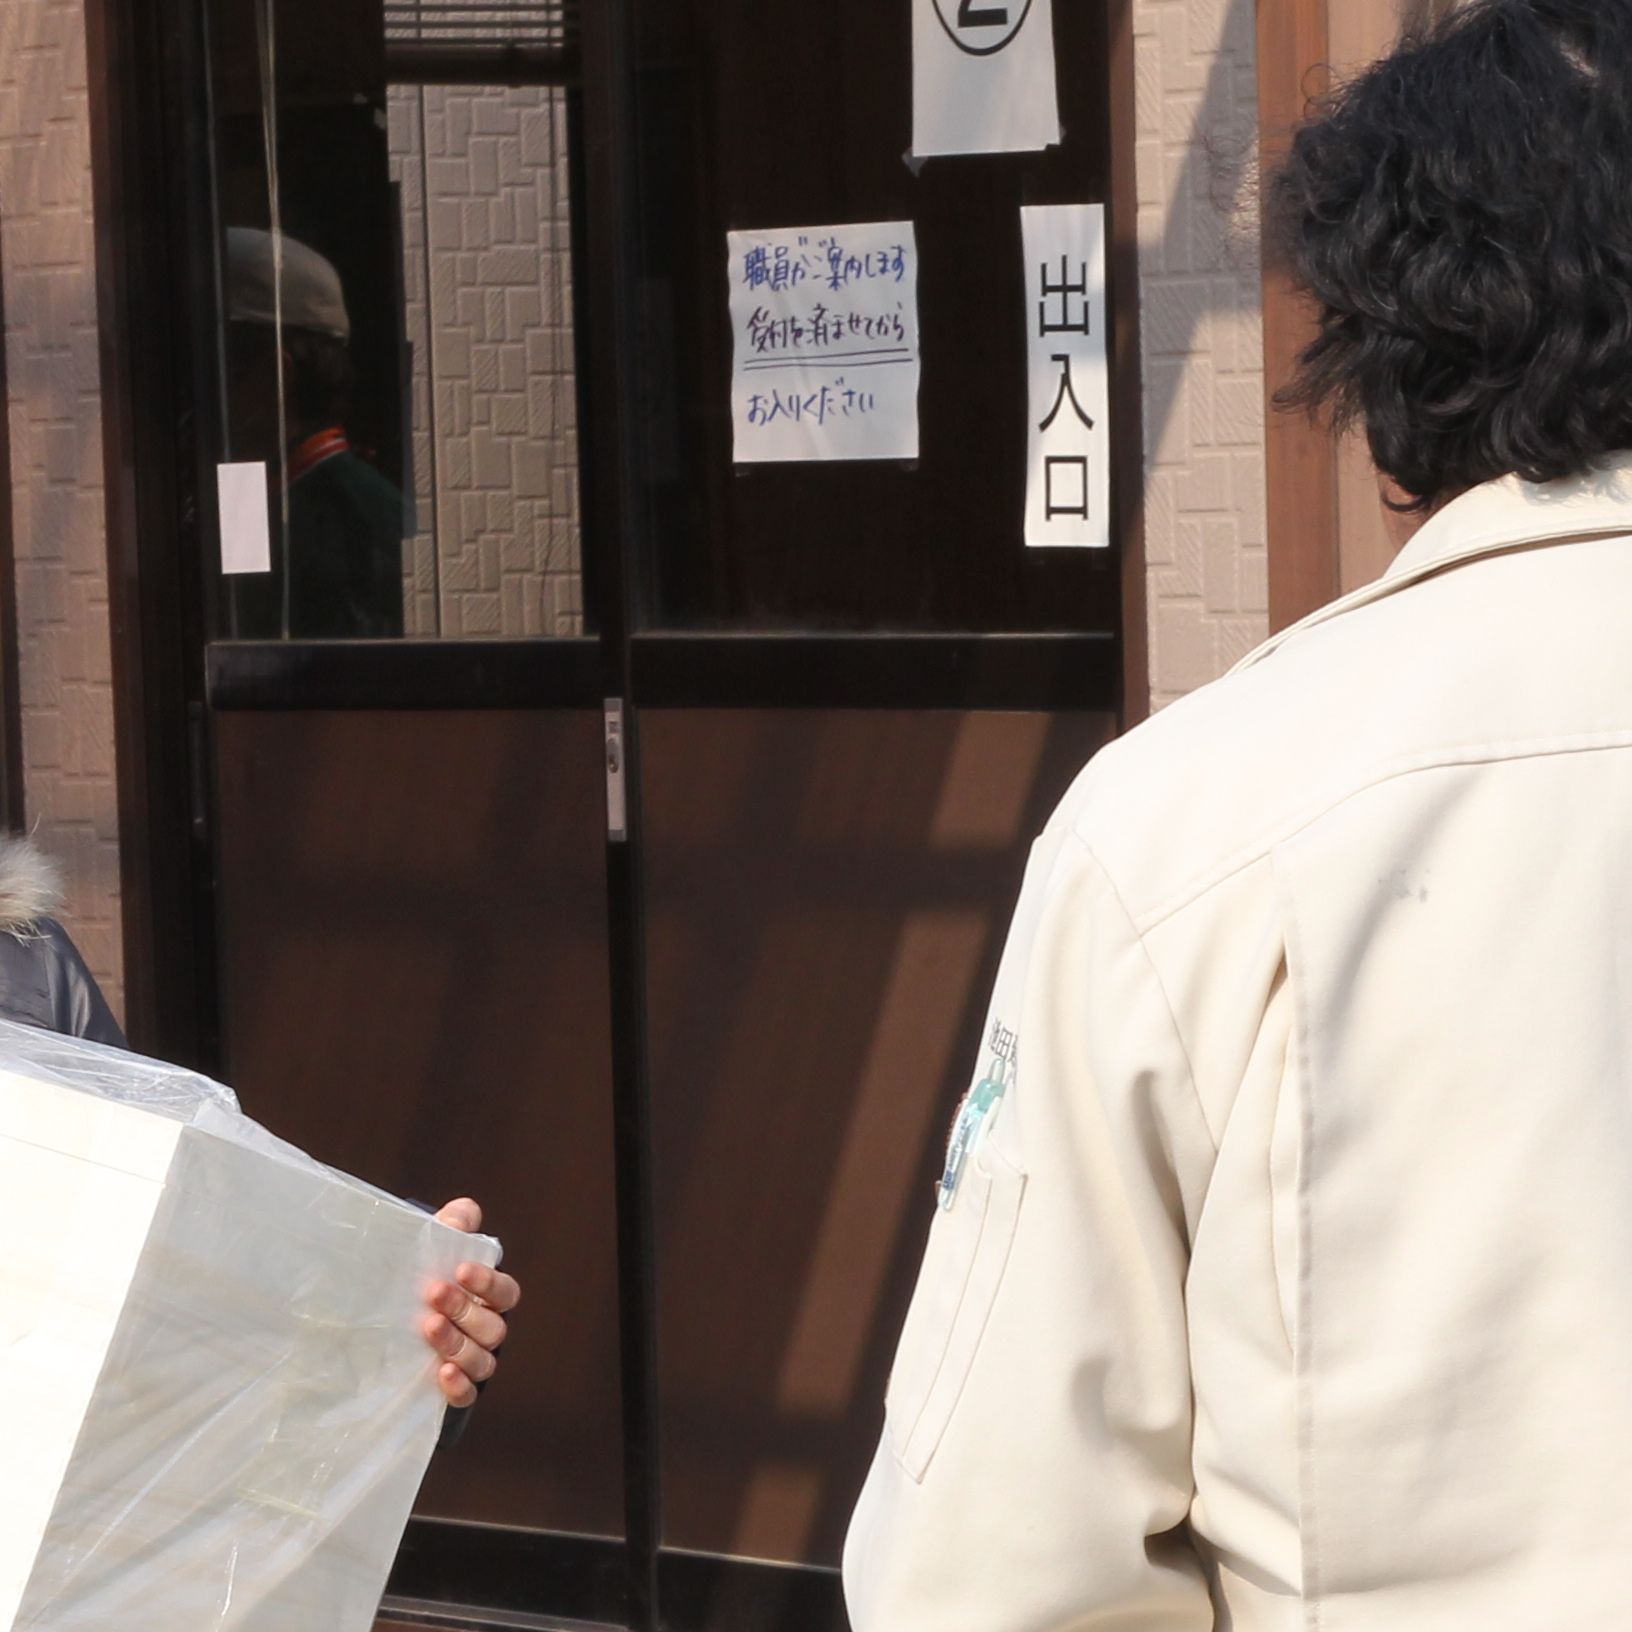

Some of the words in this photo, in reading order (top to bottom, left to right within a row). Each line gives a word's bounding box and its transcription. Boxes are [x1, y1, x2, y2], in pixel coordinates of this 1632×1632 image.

[743, 237, 906, 292] 職員がご案内します
[746, 301, 906, 352] 受付を済ませてから
[747, 376, 874, 427] お入りください
[1039, 254, 1095, 522] 出入口
